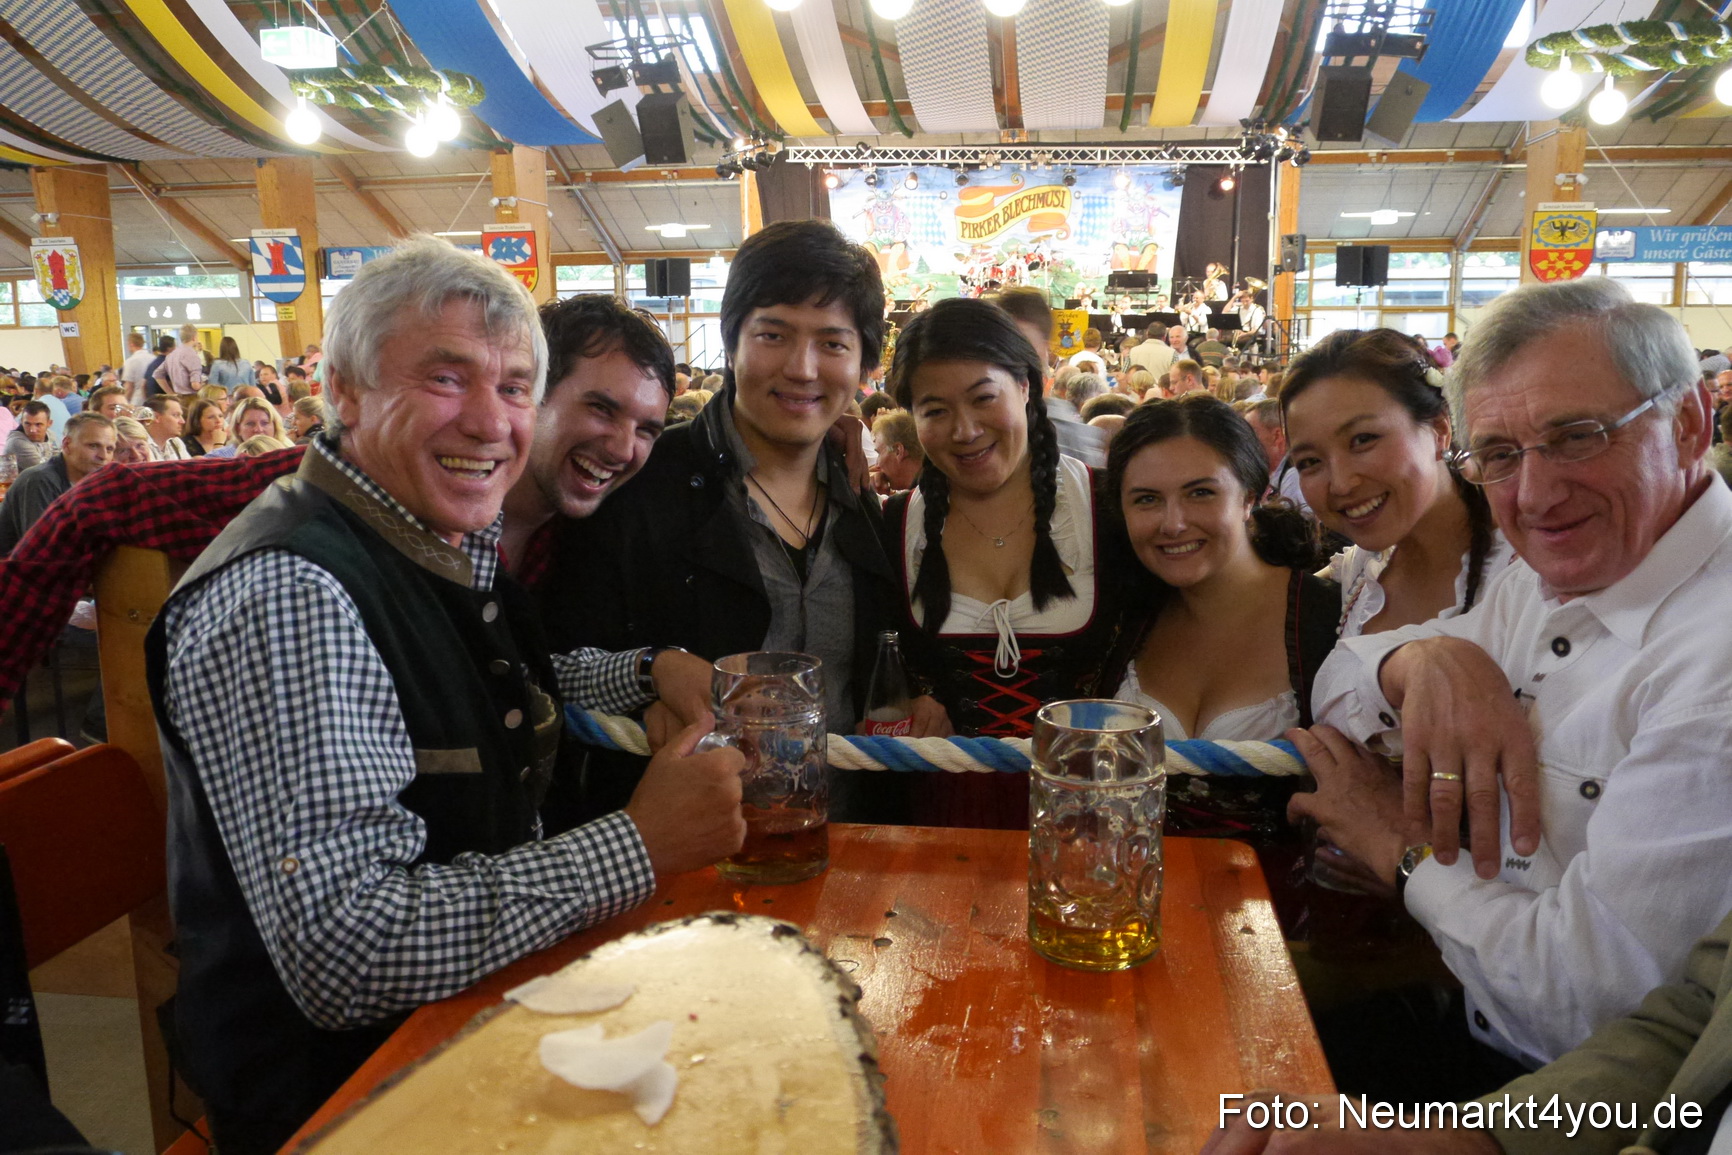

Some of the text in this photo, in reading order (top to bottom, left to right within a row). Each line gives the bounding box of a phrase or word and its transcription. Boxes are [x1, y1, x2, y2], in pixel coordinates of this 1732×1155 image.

[961, 190, 1066, 239] PIRKER BLECHMUSI
[1650, 226, 1732, 247] Wir grüßen
[1643, 244, 1732, 259] unsere Gäste
